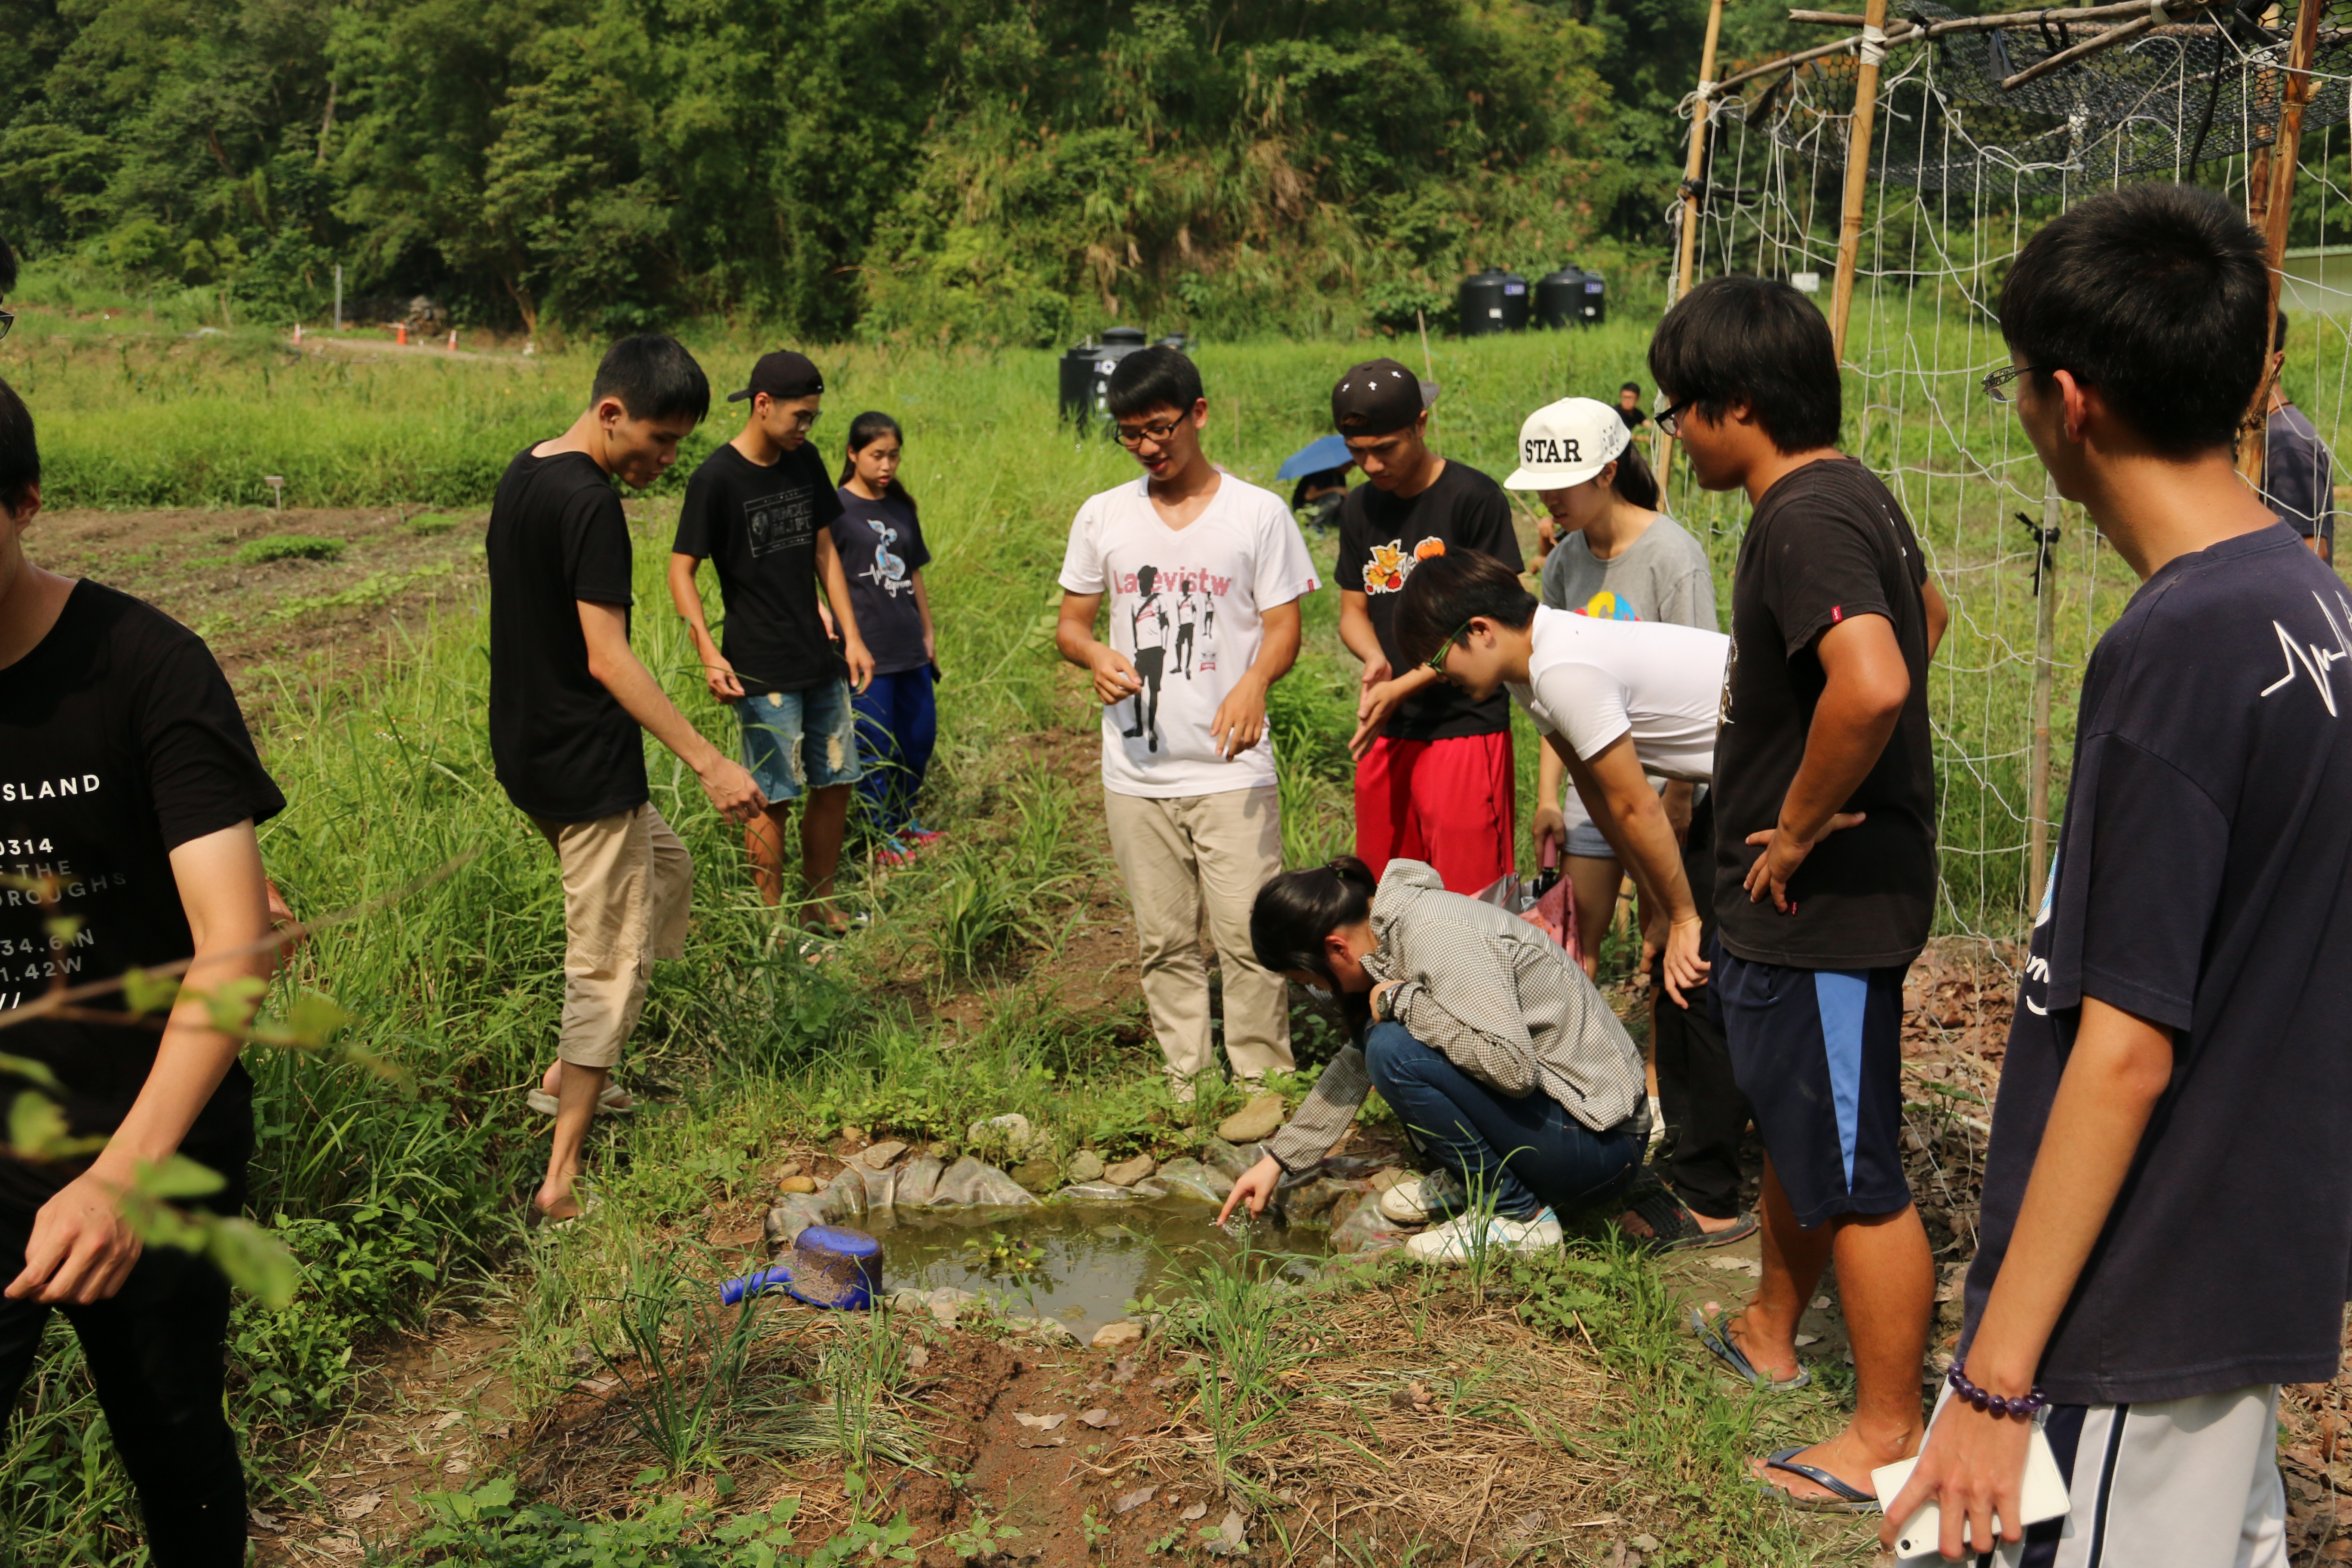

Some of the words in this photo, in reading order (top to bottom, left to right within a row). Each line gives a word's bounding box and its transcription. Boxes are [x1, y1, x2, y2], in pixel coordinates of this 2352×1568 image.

[1525, 439, 1582, 463] STAR
[1113, 567, 1232, 597] Laevistw
[16, 860, 72, 880] THE
[0, 873, 126, 906] ROUGHS
